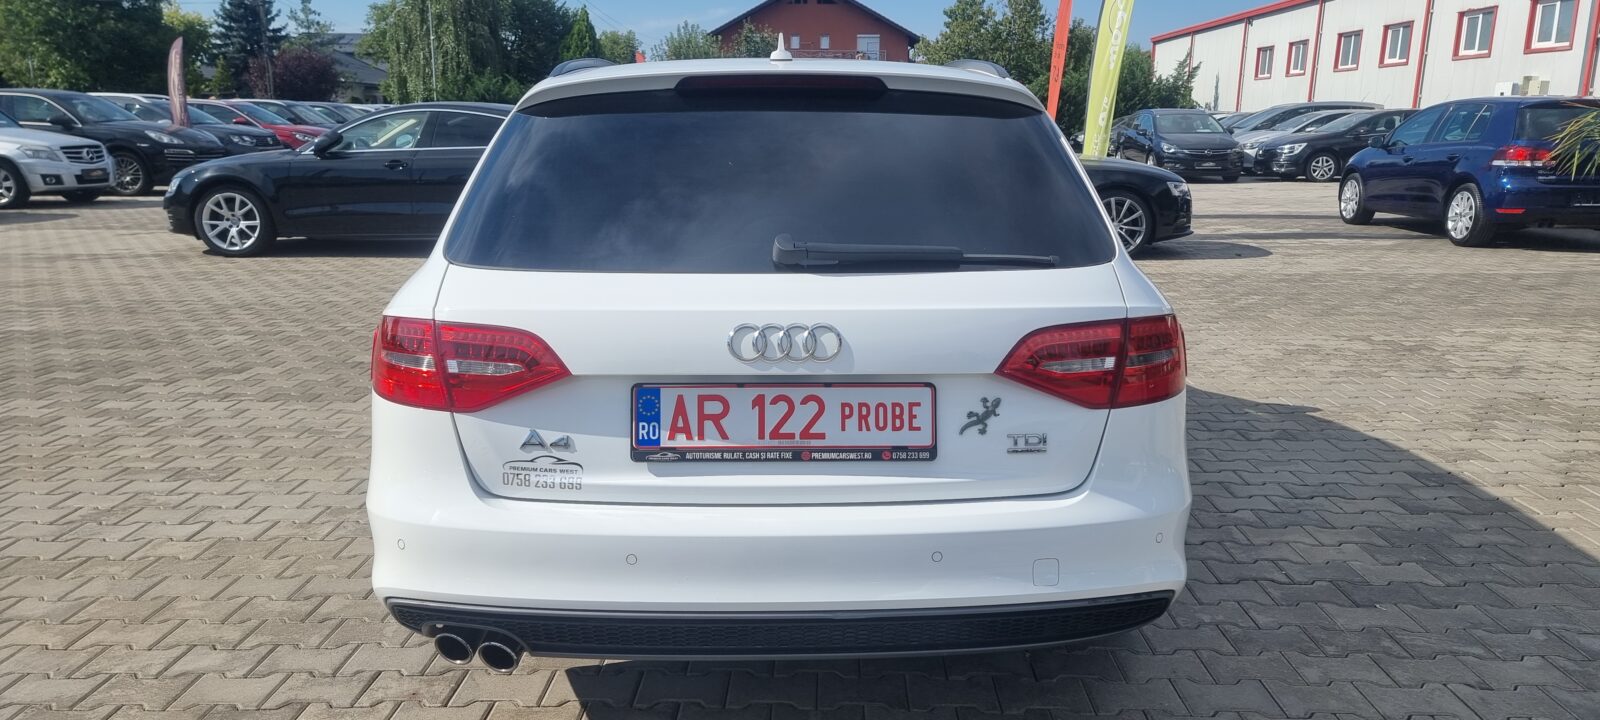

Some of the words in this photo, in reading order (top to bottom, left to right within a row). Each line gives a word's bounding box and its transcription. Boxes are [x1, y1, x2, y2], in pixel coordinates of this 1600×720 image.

[668, 394, 730, 440] AR
[752, 394, 826, 440] 122
[841, 402, 921, 431] PROBE
[639, 422, 659, 440] RO
[519, 429, 578, 454] A4
[1007, 433, 1047, 446] TDI
[686, 452, 722, 460] AUTOTURISME
[746, 452, 760, 460] CASH
[767, 452, 780, 460] RATE
[811, 452, 872, 460] PREMIUMCARSWEST.RO
[502, 472, 531, 487] 0758
